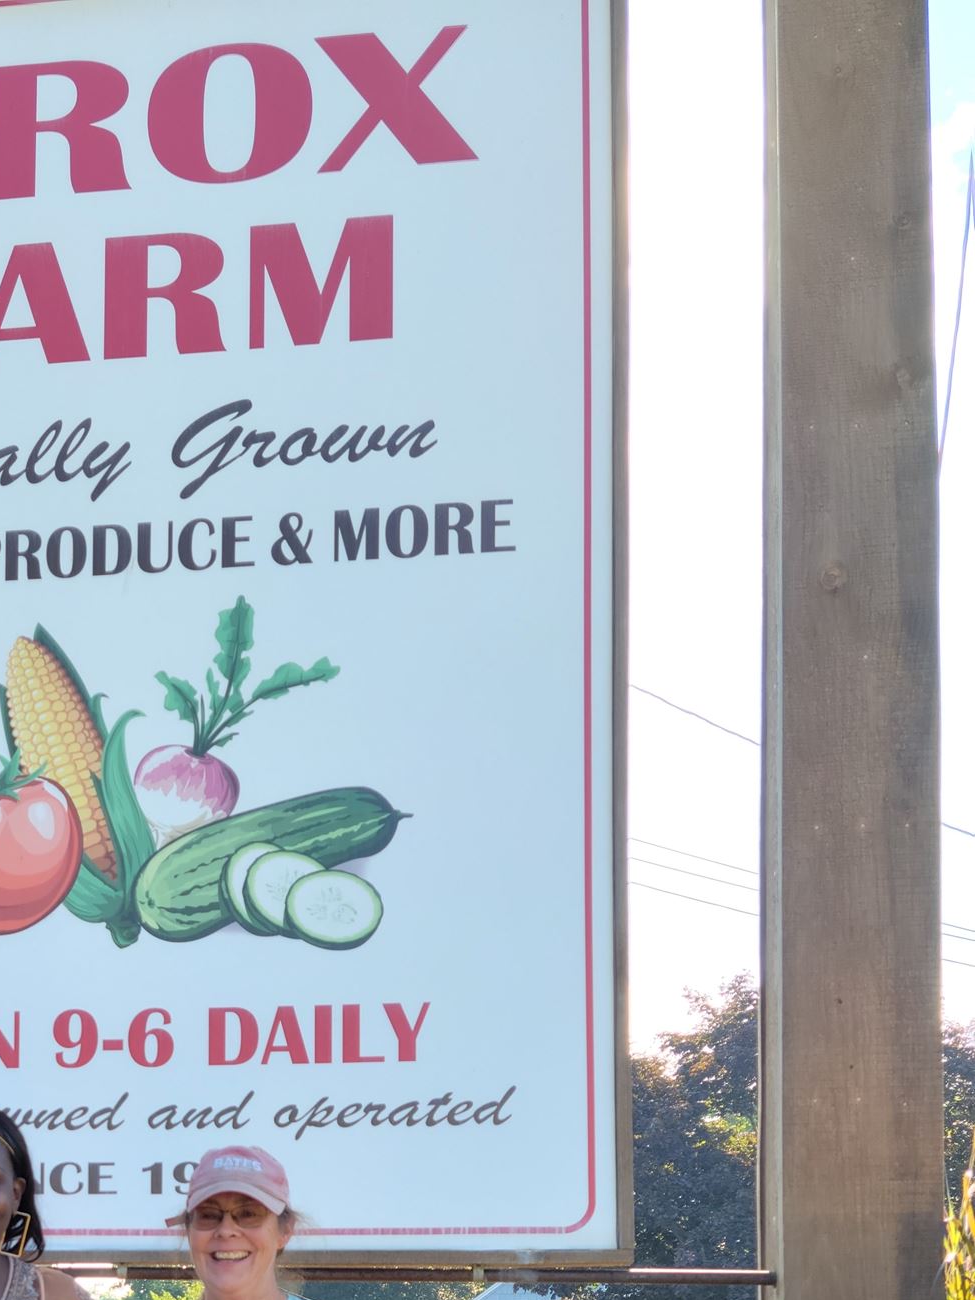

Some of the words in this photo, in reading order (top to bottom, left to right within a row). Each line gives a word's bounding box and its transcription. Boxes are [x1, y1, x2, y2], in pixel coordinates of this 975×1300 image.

[171, 399, 438, 500] Grown
[270, 512, 313, 566] &
[333, 499, 516, 562] MORE
[52, 1008, 175, 1069] 9-6
[207, 1002, 430, 1067] DAILY
[147, 1090, 255, 1131] and
[273, 1085, 517, 1141] operated
